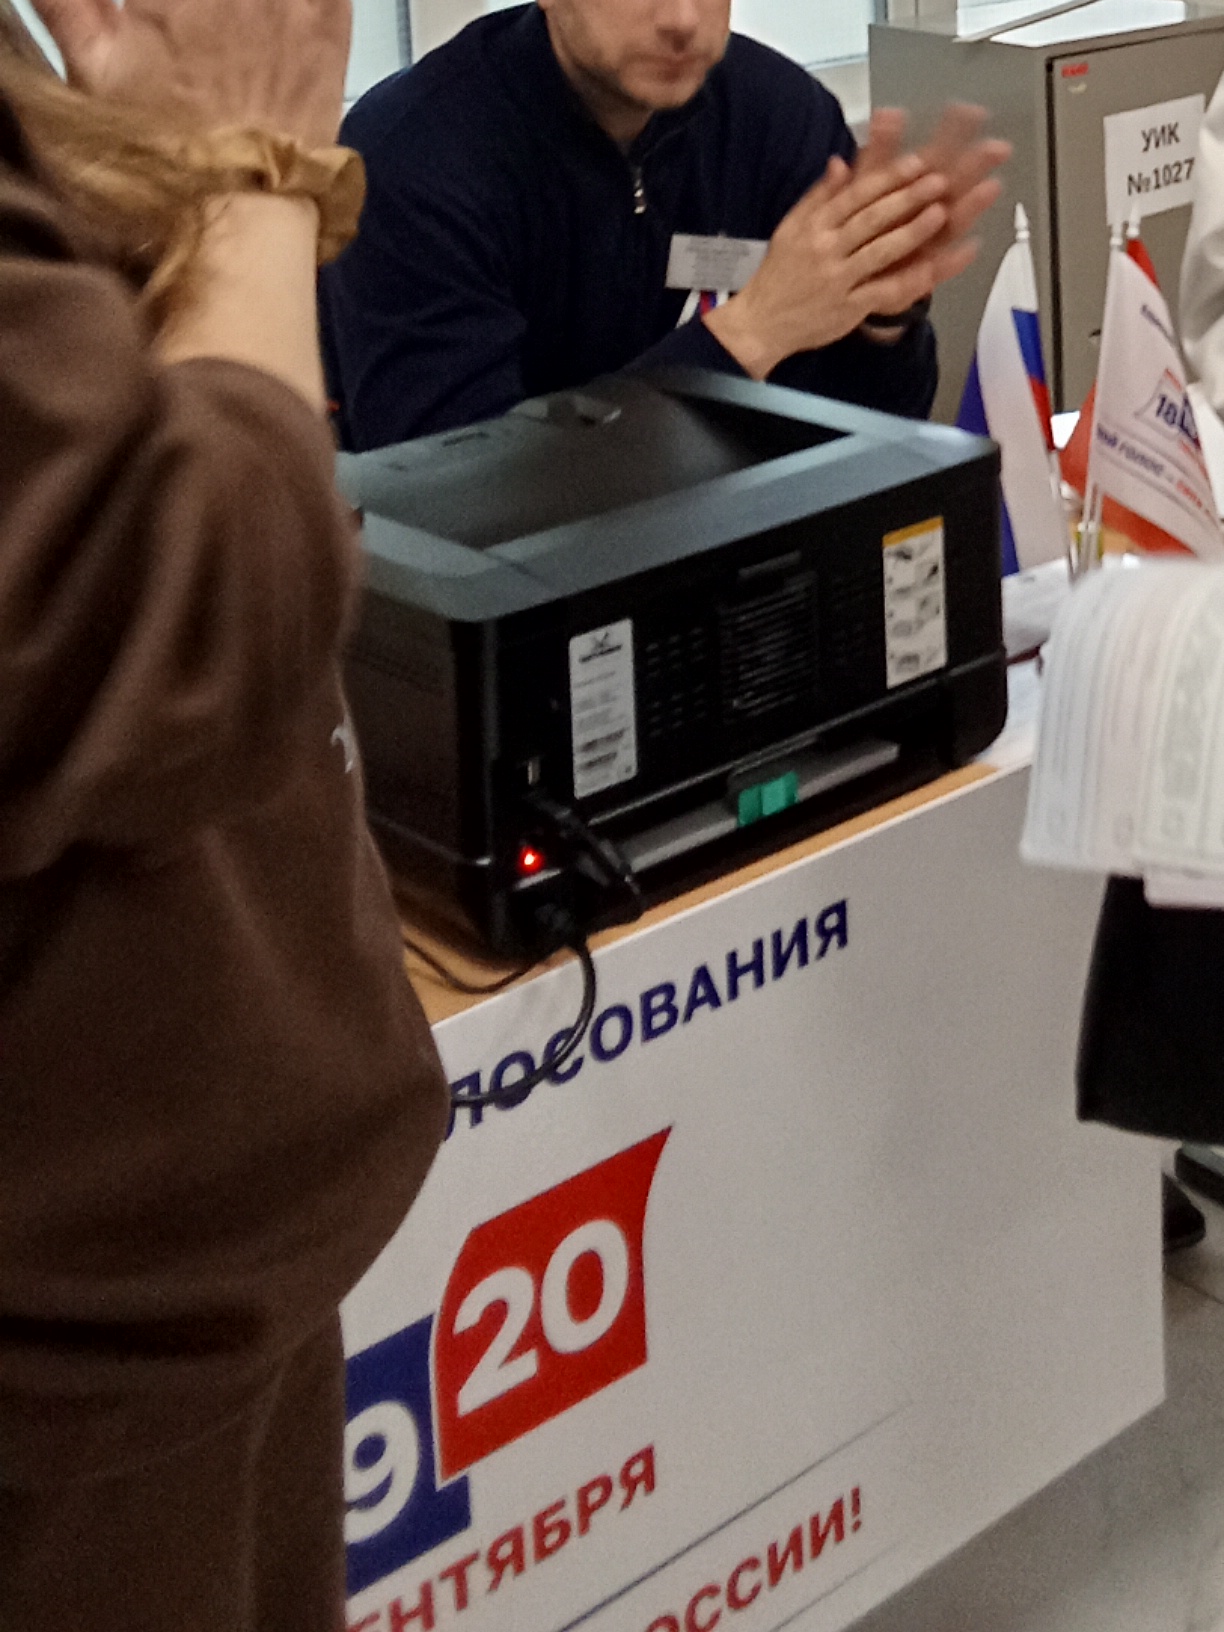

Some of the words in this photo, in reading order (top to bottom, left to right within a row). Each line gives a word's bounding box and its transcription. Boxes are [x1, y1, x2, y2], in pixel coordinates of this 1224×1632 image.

[1127, 157, 1195, 196] №1027
[1141, 121, 1180, 152] УИК
[444, 899, 848, 1141] ЛОСОВАНИЯ
[453, 1218, 630, 1418] 20
[346, 1443, 656, 1632] НТЯБРЯ
[645, 1485, 862, 1632] ССИИ!
